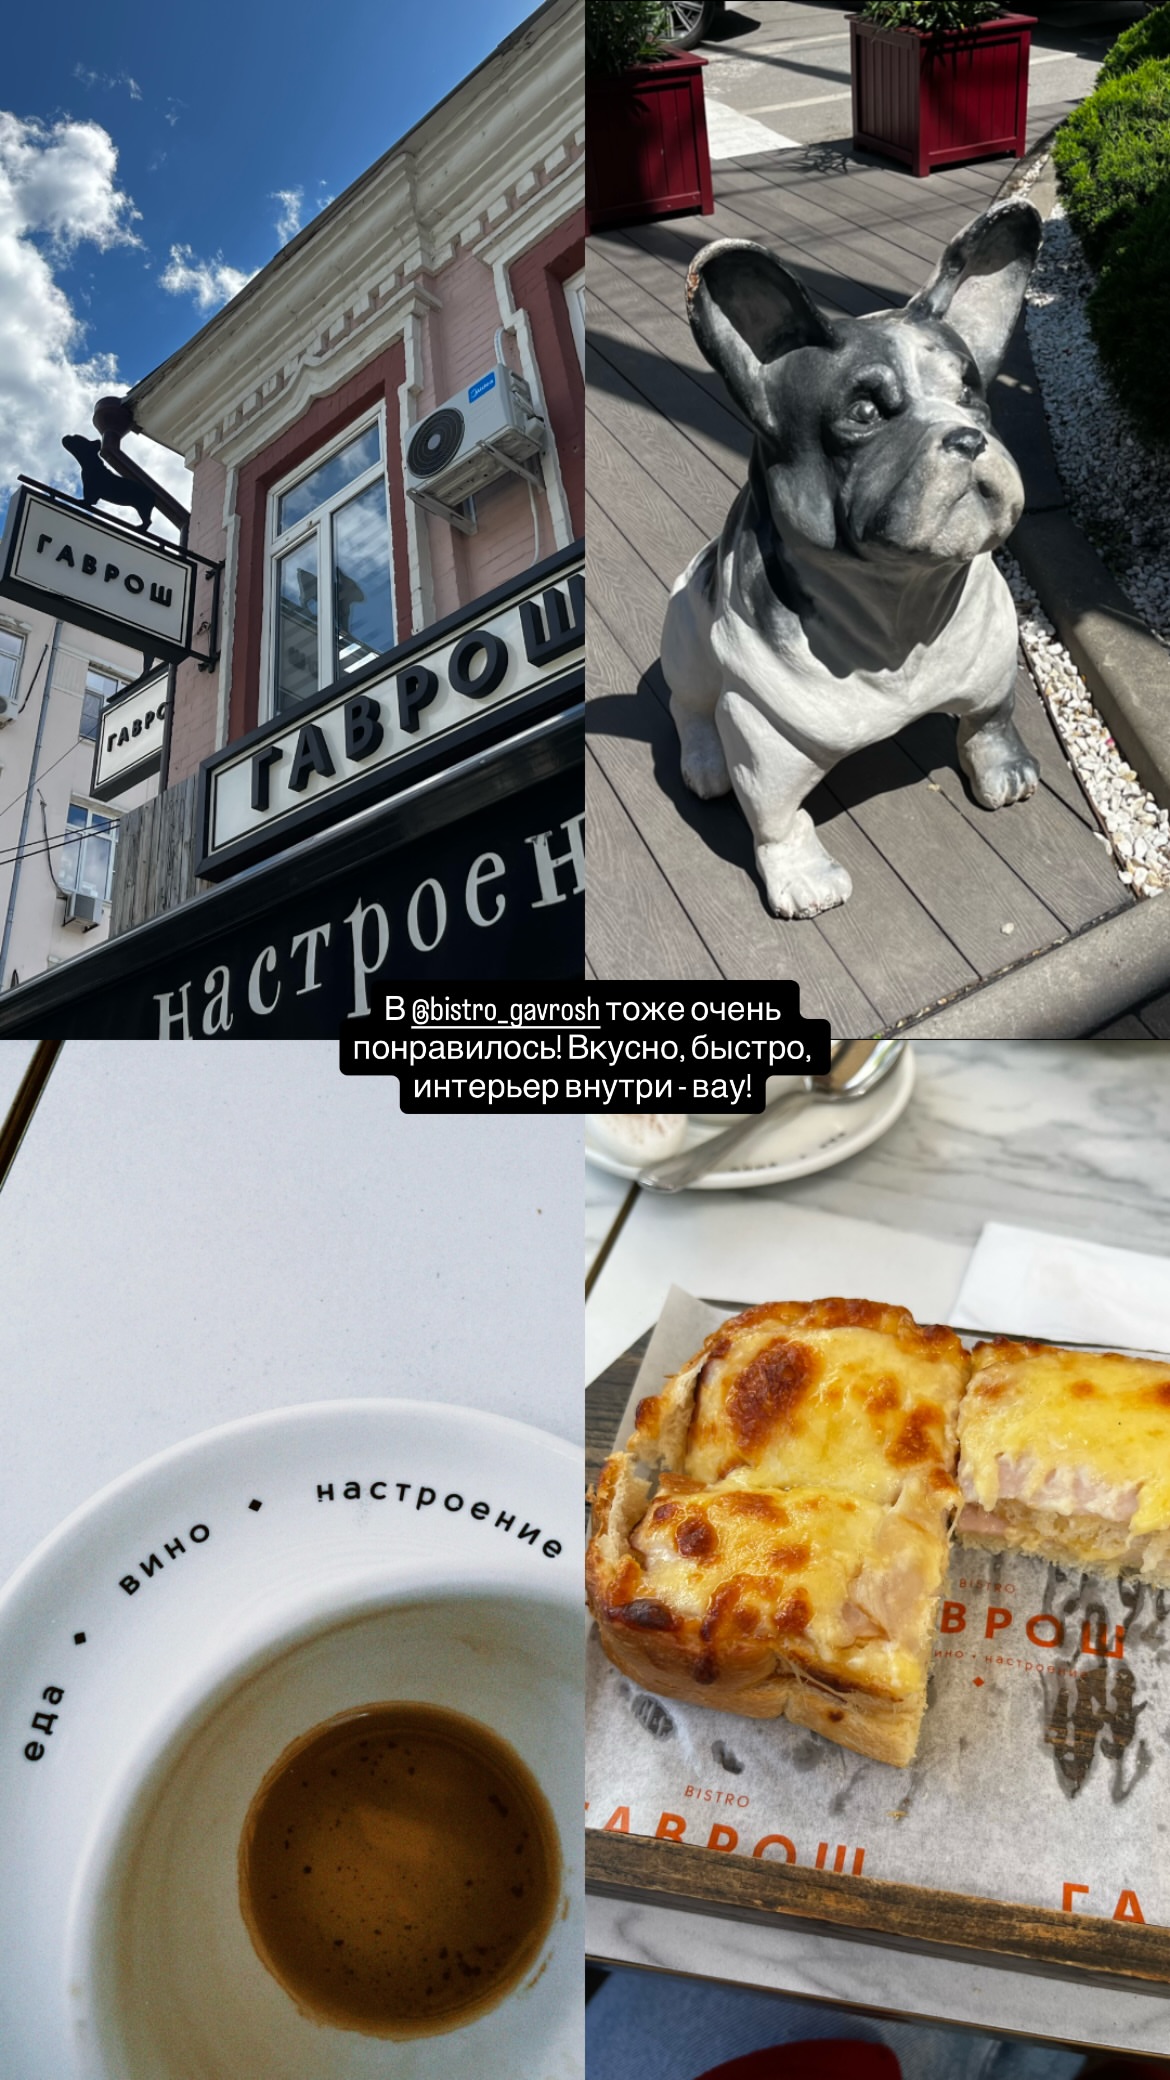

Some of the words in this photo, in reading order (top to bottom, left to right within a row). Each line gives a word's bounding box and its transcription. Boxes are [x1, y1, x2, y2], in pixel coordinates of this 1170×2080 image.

[36, 533, 173, 608] ГАВРОШ
[251, 573, 585, 812] ГАВРОШ
[959, 1578, 1016, 1594] BISTRO
[24, 1686, 65, 1762] еда
[118, 1523, 211, 1596] вино
[316, 1481, 562, 1559] настроение
[939, 1600, 1126, 1660] ВРОШ
[984, 1655, 1090, 1680] настроение
[683, 1784, 750, 1809] BISTRO
[584, 1802, 866, 1877] АВРОШ
